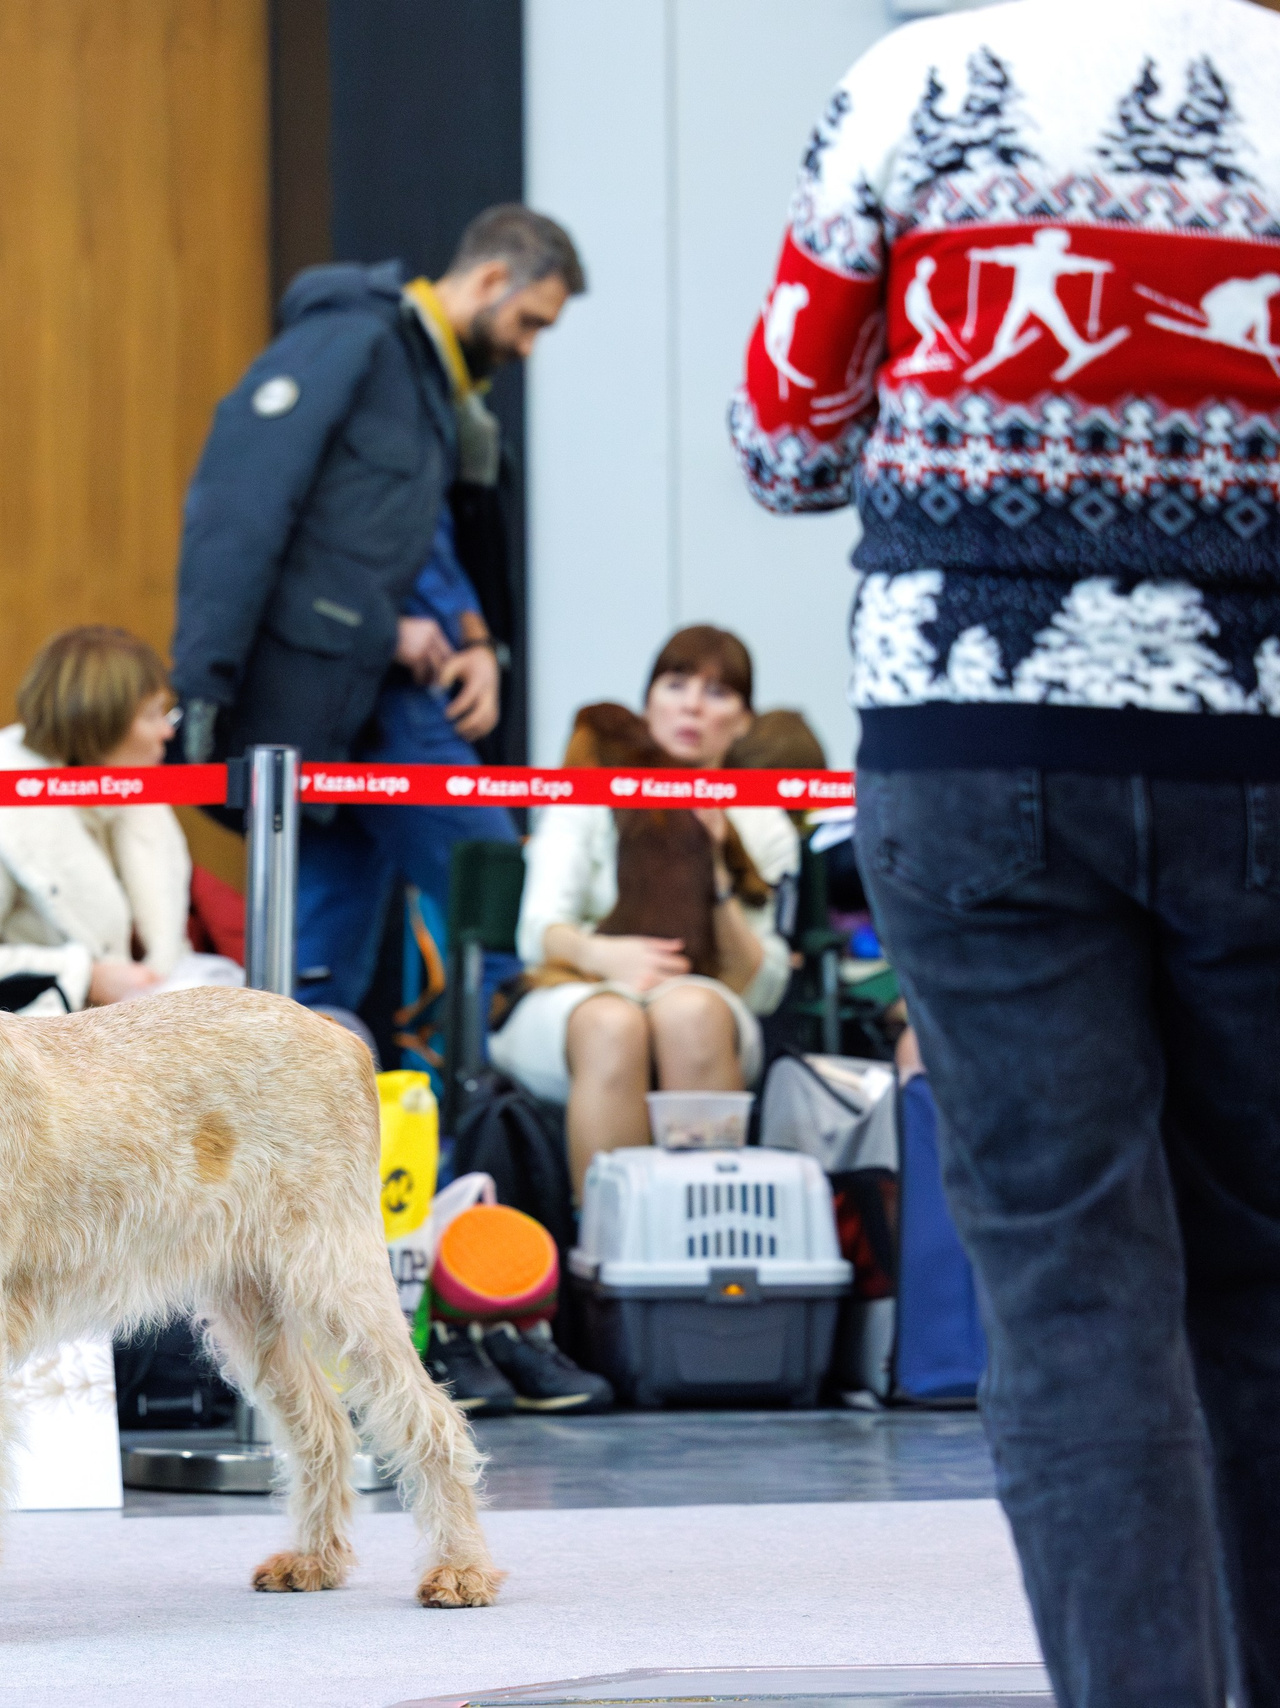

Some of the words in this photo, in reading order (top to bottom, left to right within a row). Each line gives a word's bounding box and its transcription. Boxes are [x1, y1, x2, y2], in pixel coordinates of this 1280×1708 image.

[47, 777, 99, 796] Kazan
[100, 776, 143, 798] Expo
[313, 773, 365, 792] Kazan
[367, 773, 410, 796] Expo
[477, 777, 529, 797] Kazan
[530, 777, 573, 801] Expo
[641, 778, 693, 798] Kazan
[693, 778, 737, 801] Expo
